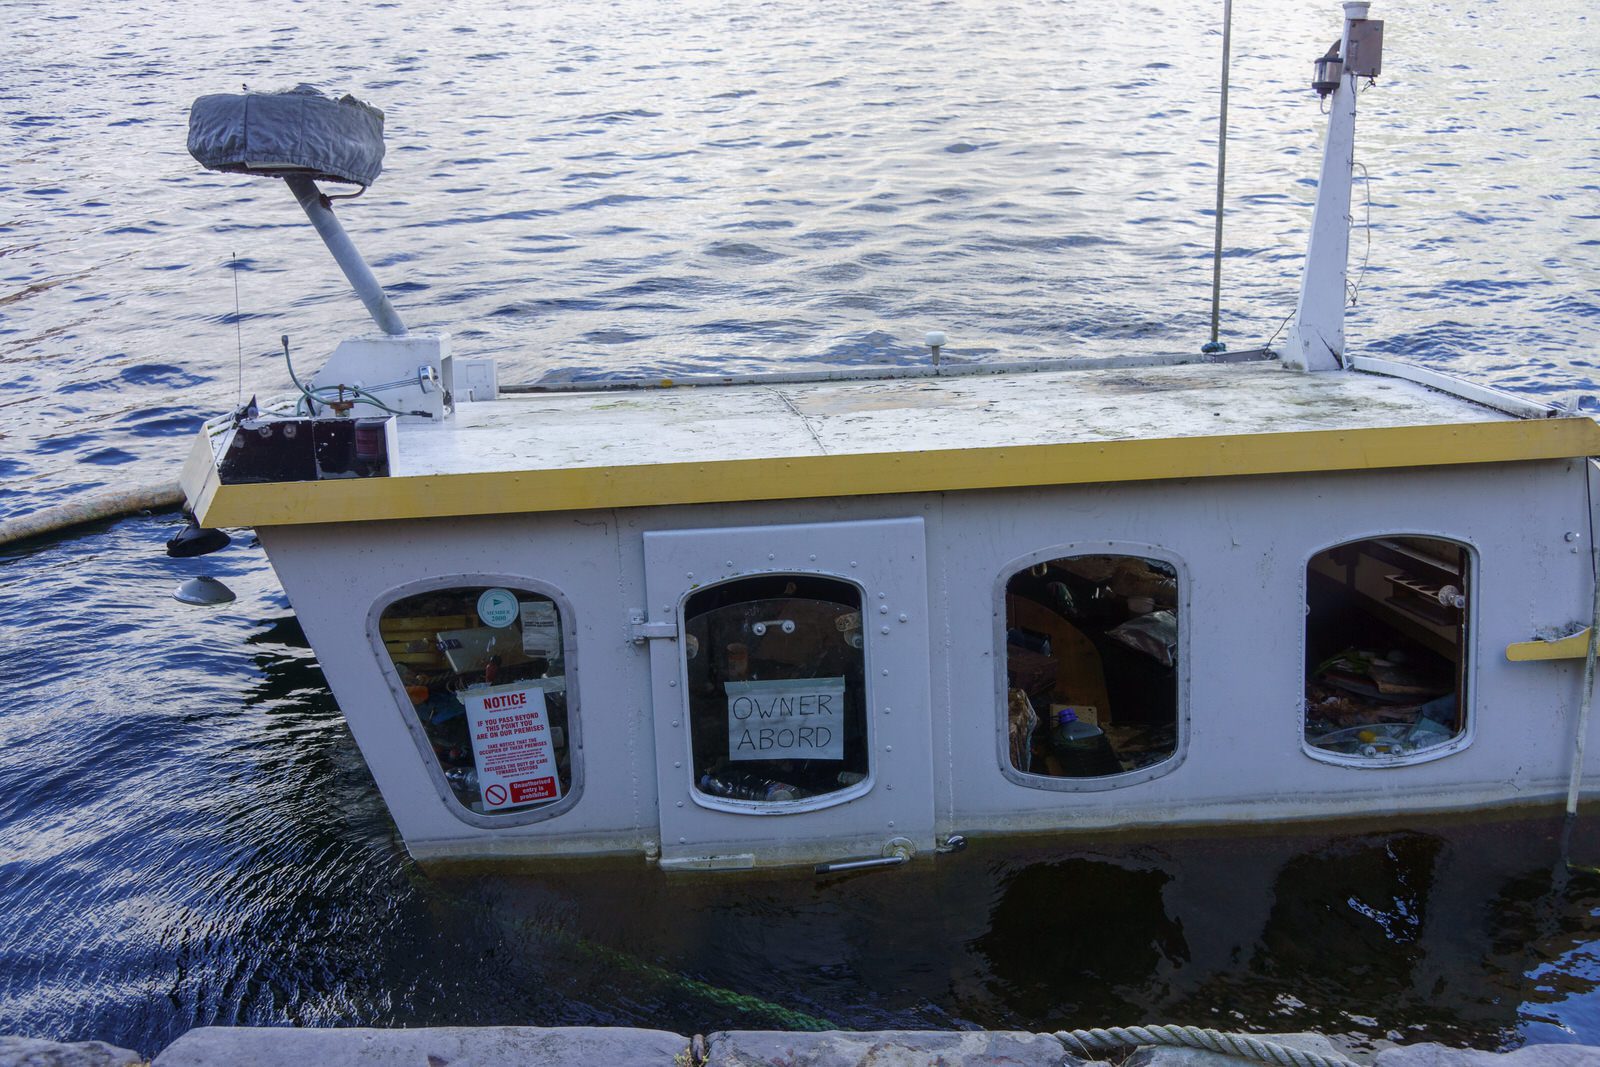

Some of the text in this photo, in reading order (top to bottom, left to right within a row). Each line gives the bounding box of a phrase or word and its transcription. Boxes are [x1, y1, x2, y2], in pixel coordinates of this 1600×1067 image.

[483, 692, 527, 710] NOTICE
[732, 694, 832, 720] OWNER
[515, 712, 538, 721] BEYOND
[501, 722, 518, 730] POINT
[514, 724, 544, 734] PREMISES
[737, 726, 832, 750] ABORD
[479, 747, 502, 755] OCCUPIER
[525, 741, 547, 749] PREMISES
[496, 767, 517, 775] TOWARDS
[513, 778, 550, 788] Unauthorised
[520, 791, 548, 800] prohibited
